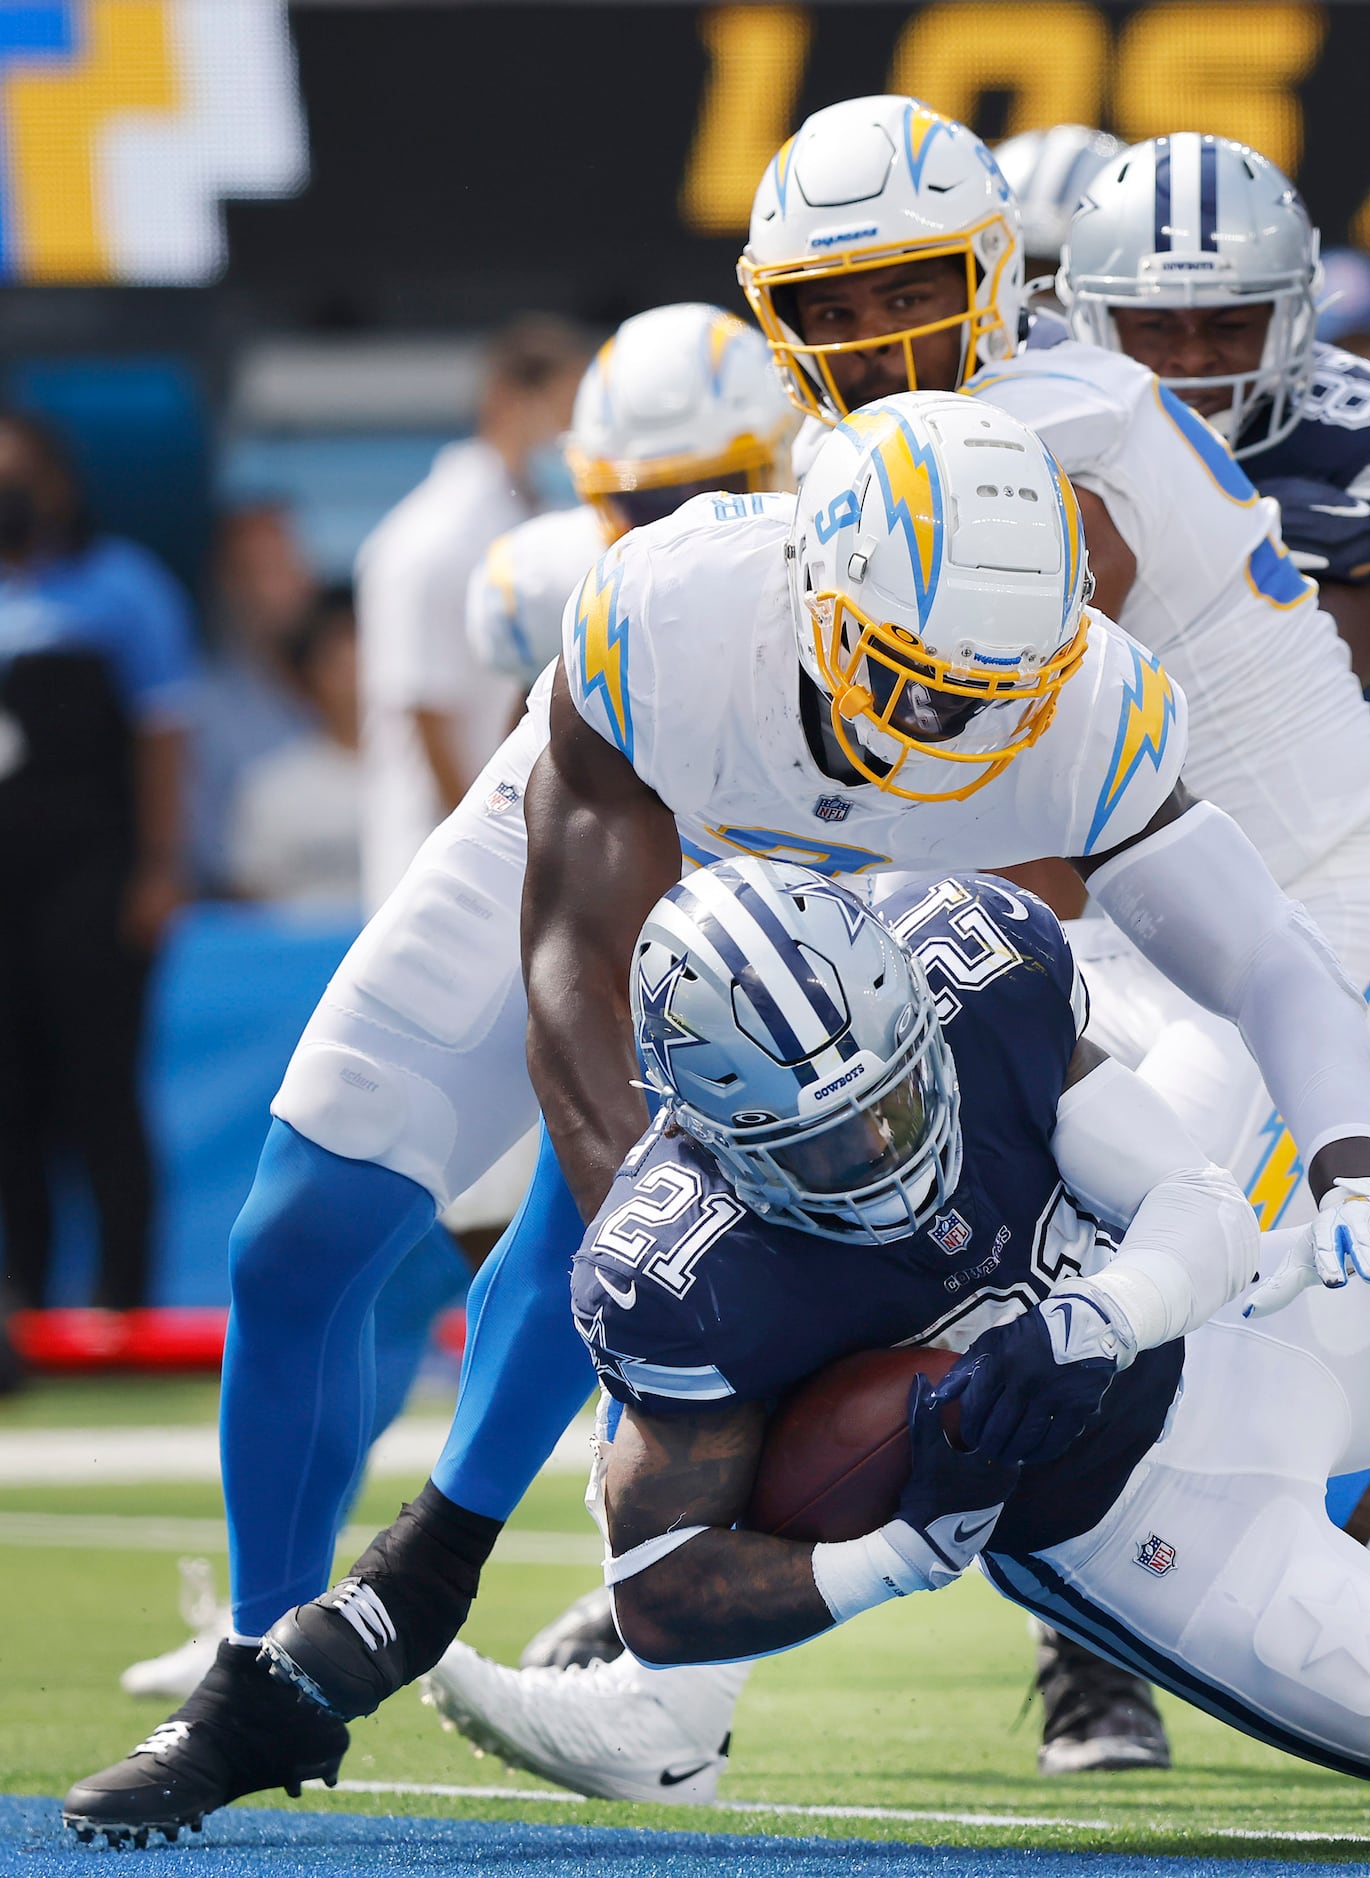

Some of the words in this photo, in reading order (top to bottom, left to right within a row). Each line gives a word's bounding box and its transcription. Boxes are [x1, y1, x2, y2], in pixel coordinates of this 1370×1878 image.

[820, 807, 846, 820] NFL
[813, 1063, 865, 1101] COWBOYS
[590, 1160, 748, 1301] 21
[943, 1226, 968, 1250] NFL
[1149, 1546, 1173, 1572] NFL
